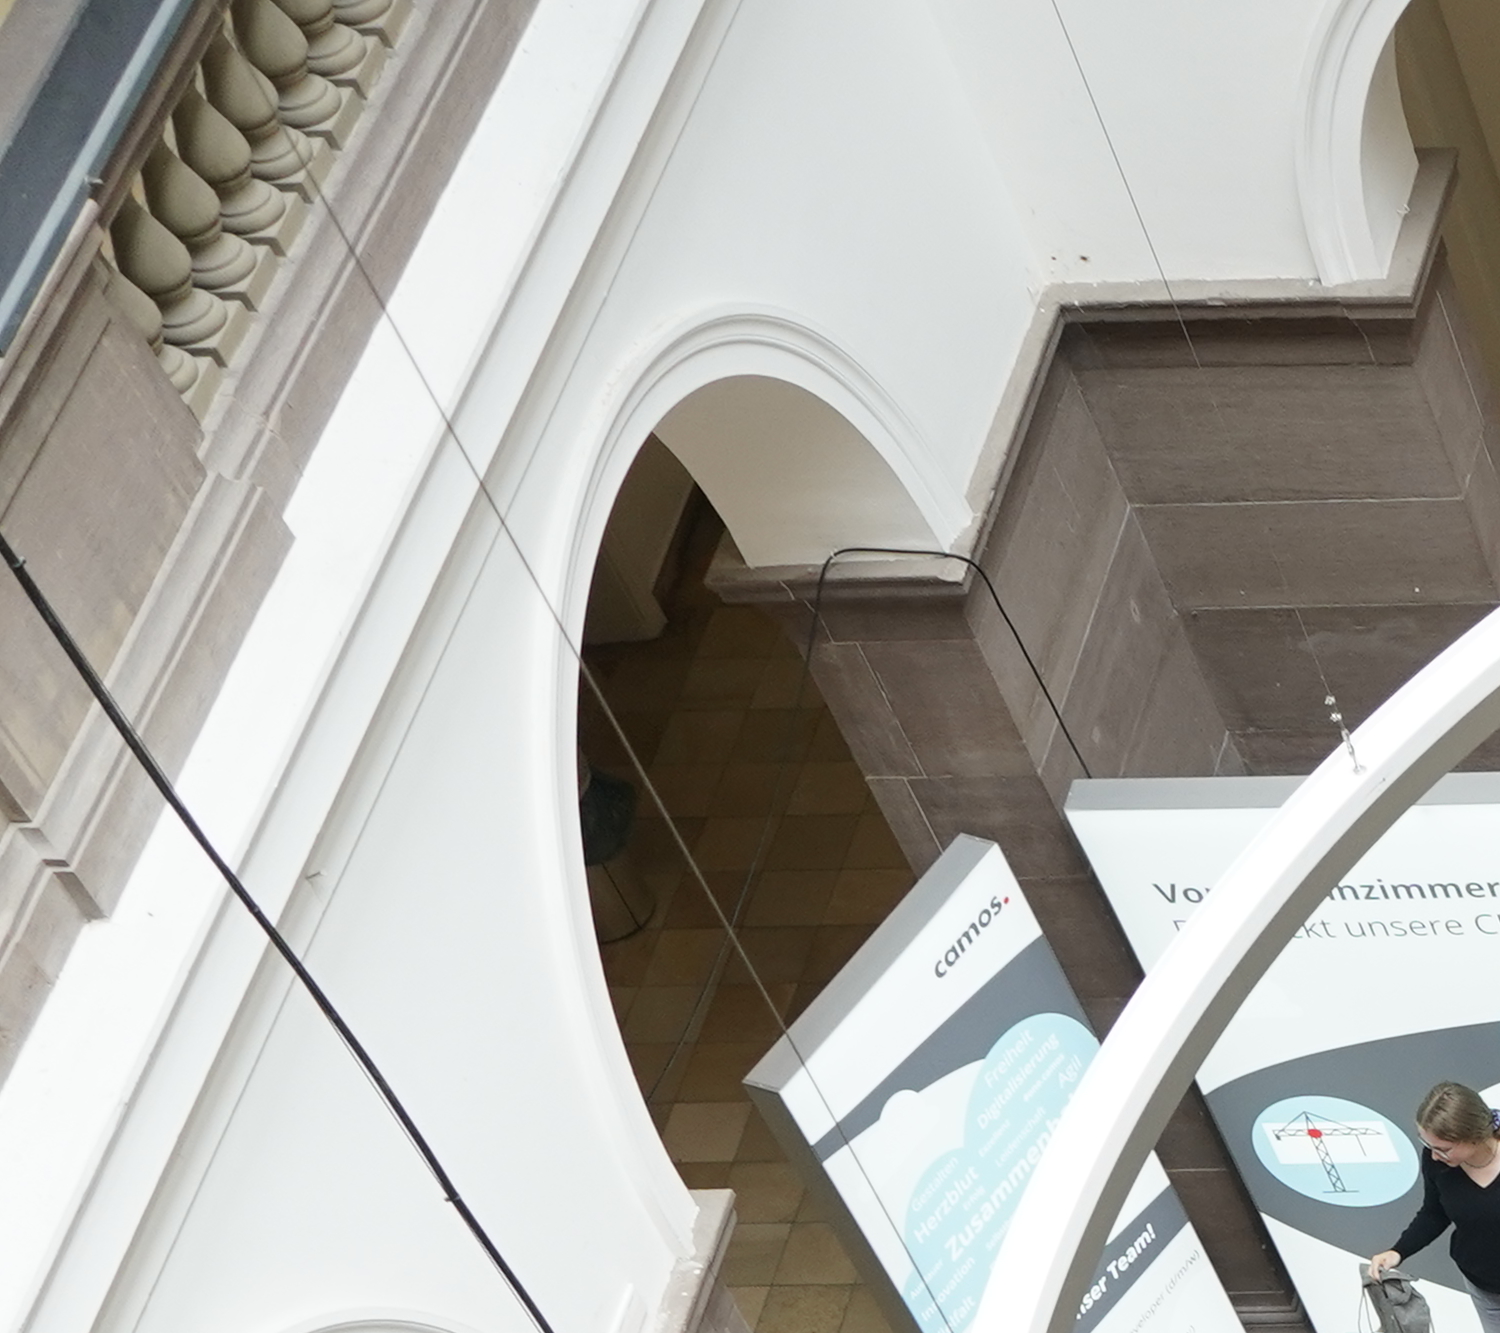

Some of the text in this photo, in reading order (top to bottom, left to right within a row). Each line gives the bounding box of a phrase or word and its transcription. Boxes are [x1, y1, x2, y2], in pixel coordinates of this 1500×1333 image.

[1153, 883, 1212, 905] Vo
[934, 895, 1010, 981] camos.
[1353, 914, 1464, 939] unsere
[976, 1033, 1061, 1131] Digitalisierung
[984, 1029, 1035, 1090] Freiheit
[1057, 1055, 1083, 1091] Agil
[911, 1156, 959, 1213] Gestalten
[913, 1166, 980, 1245] Herzblut
[1106, 1222, 1157, 1280] Team!
[920, 1256, 976, 1323] Innovation
